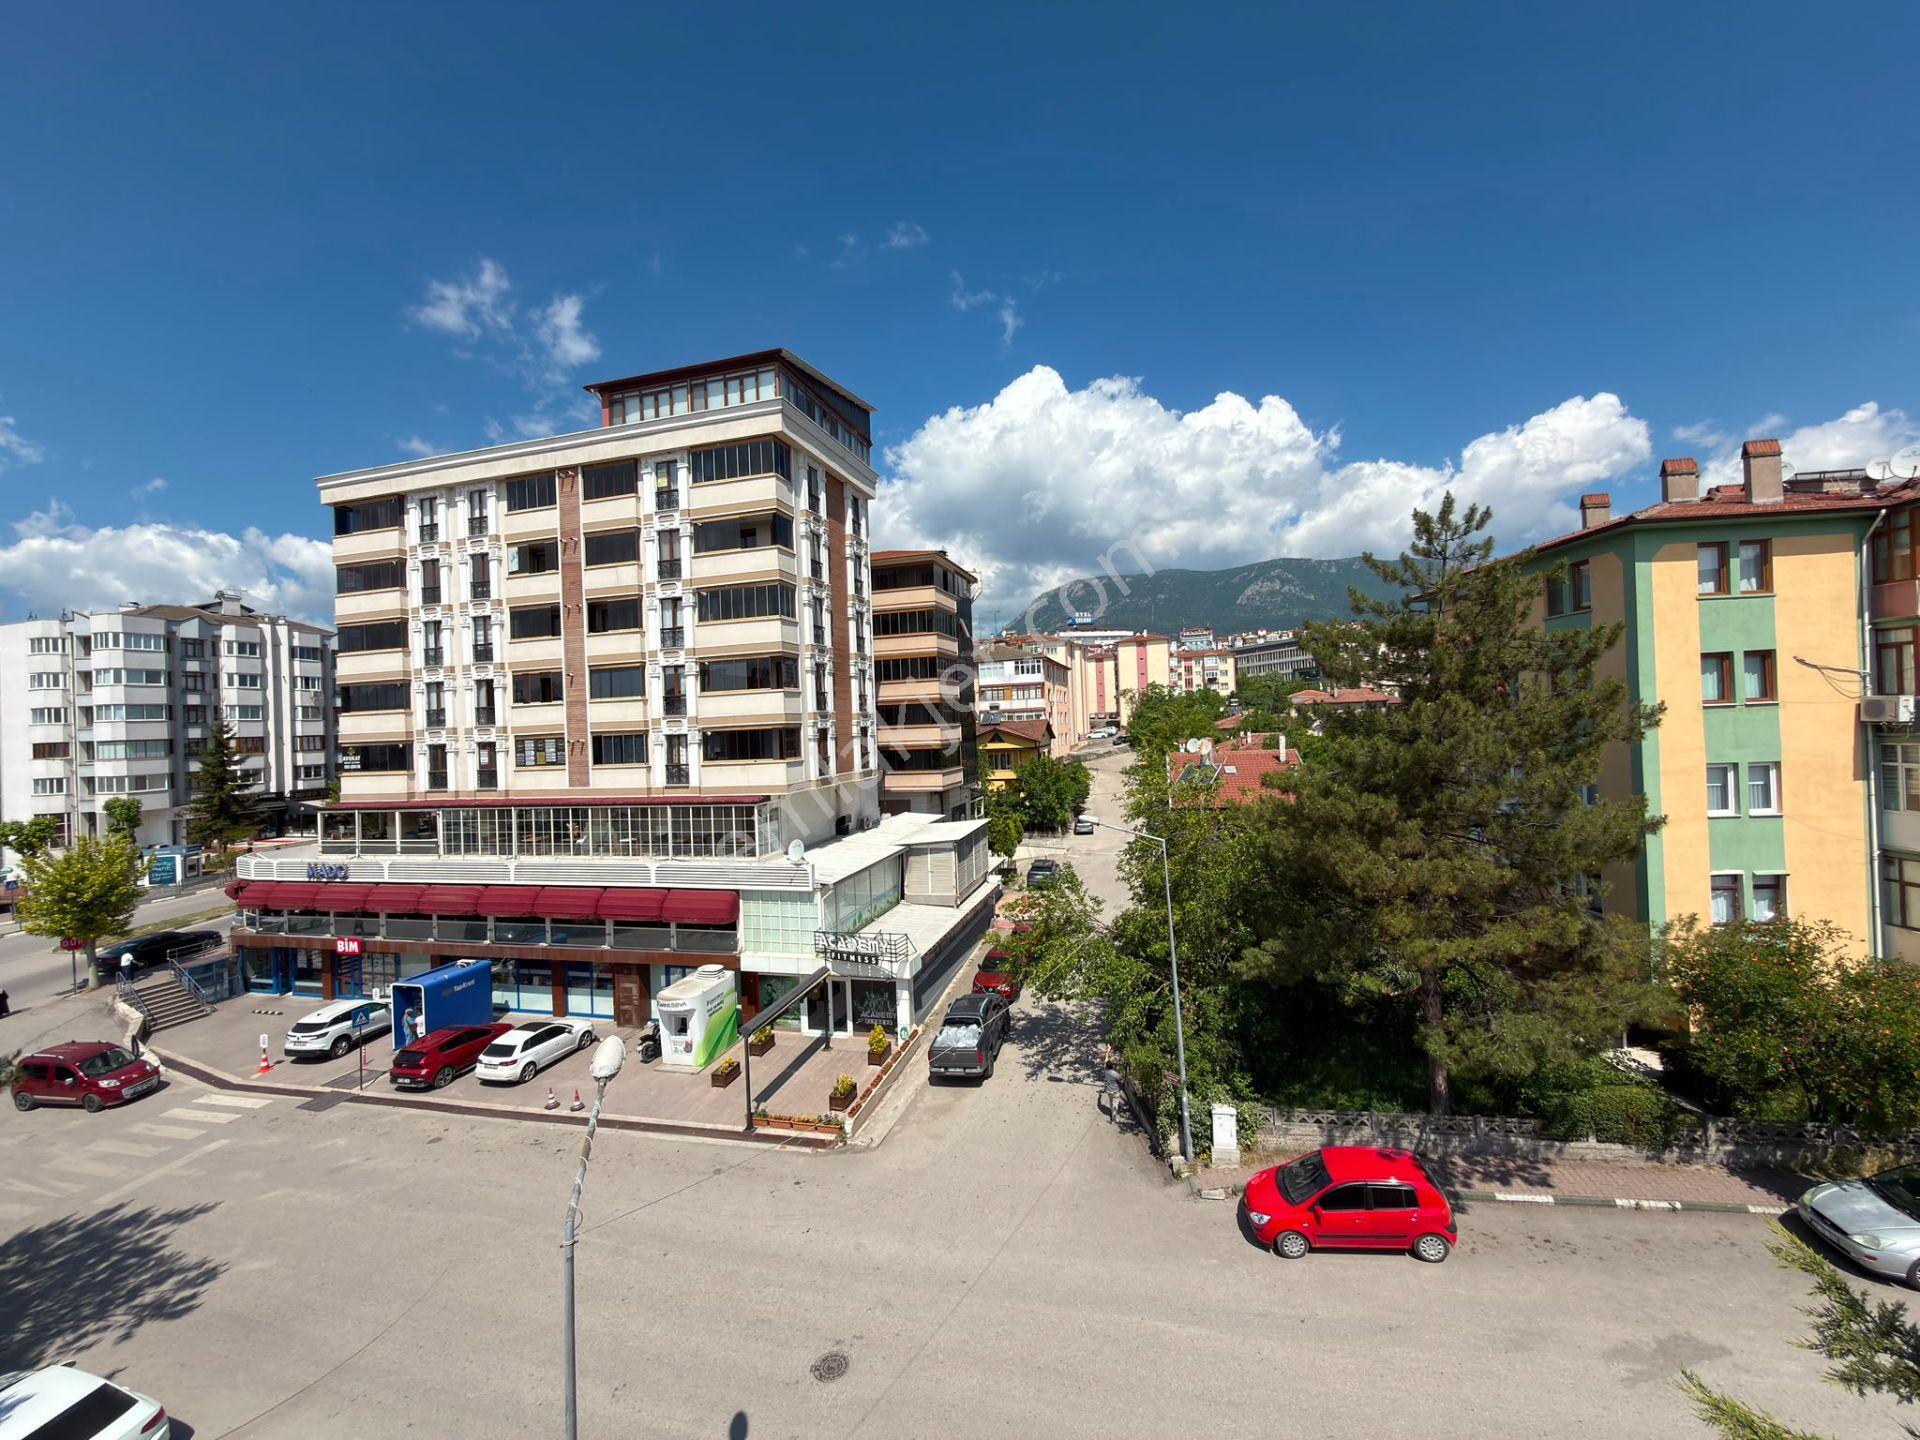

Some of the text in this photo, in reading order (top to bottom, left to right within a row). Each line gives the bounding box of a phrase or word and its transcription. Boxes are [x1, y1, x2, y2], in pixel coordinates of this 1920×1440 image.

[307, 863, 349, 880] MADO
[337, 938, 359, 952] BİM
[831, 953, 877, 964] FITNESS
